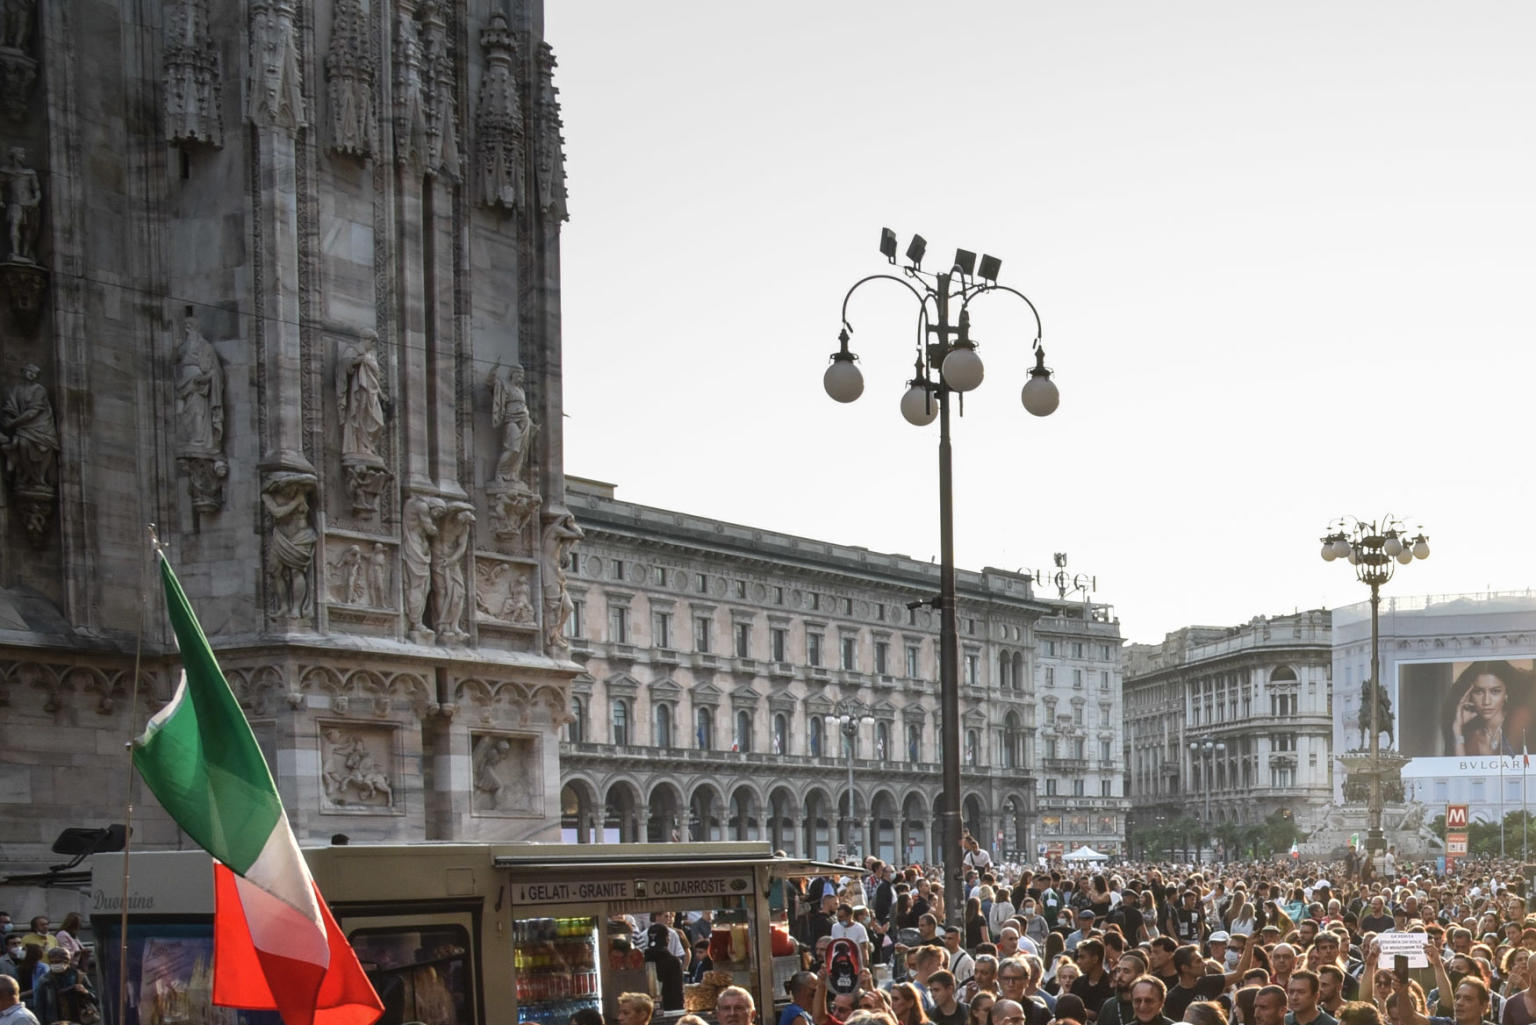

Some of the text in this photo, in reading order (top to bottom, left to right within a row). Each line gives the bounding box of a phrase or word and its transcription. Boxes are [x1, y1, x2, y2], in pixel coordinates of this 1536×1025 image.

[1459, 760, 1526, 770] BVLGAR
[1448, 808, 1466, 823] M
[528, 885, 569, 900] GELATI
[579, 882, 627, 898] GRANITE
[653, 879, 726, 896] CALDARROSTE
